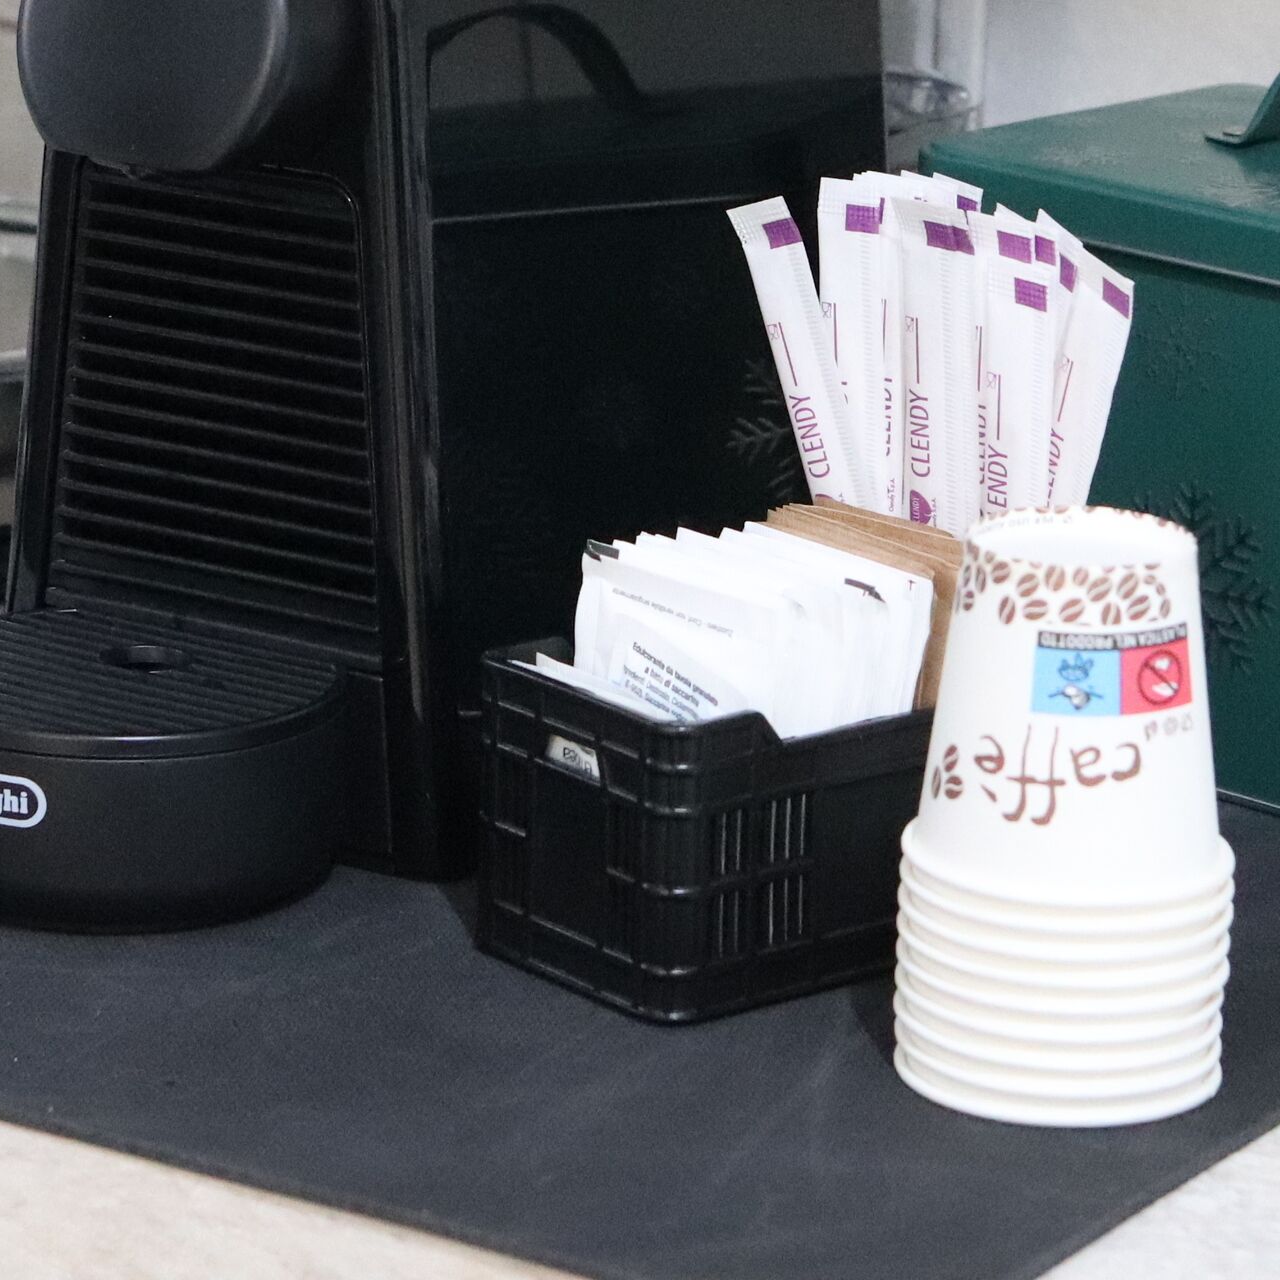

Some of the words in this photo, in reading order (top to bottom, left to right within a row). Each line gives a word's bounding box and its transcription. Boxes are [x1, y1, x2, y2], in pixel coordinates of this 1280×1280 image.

[789, 394, 831, 479] CLENDY
[909, 389, 930, 478] CLENDY
[986, 445, 1008, 510] ENDY
